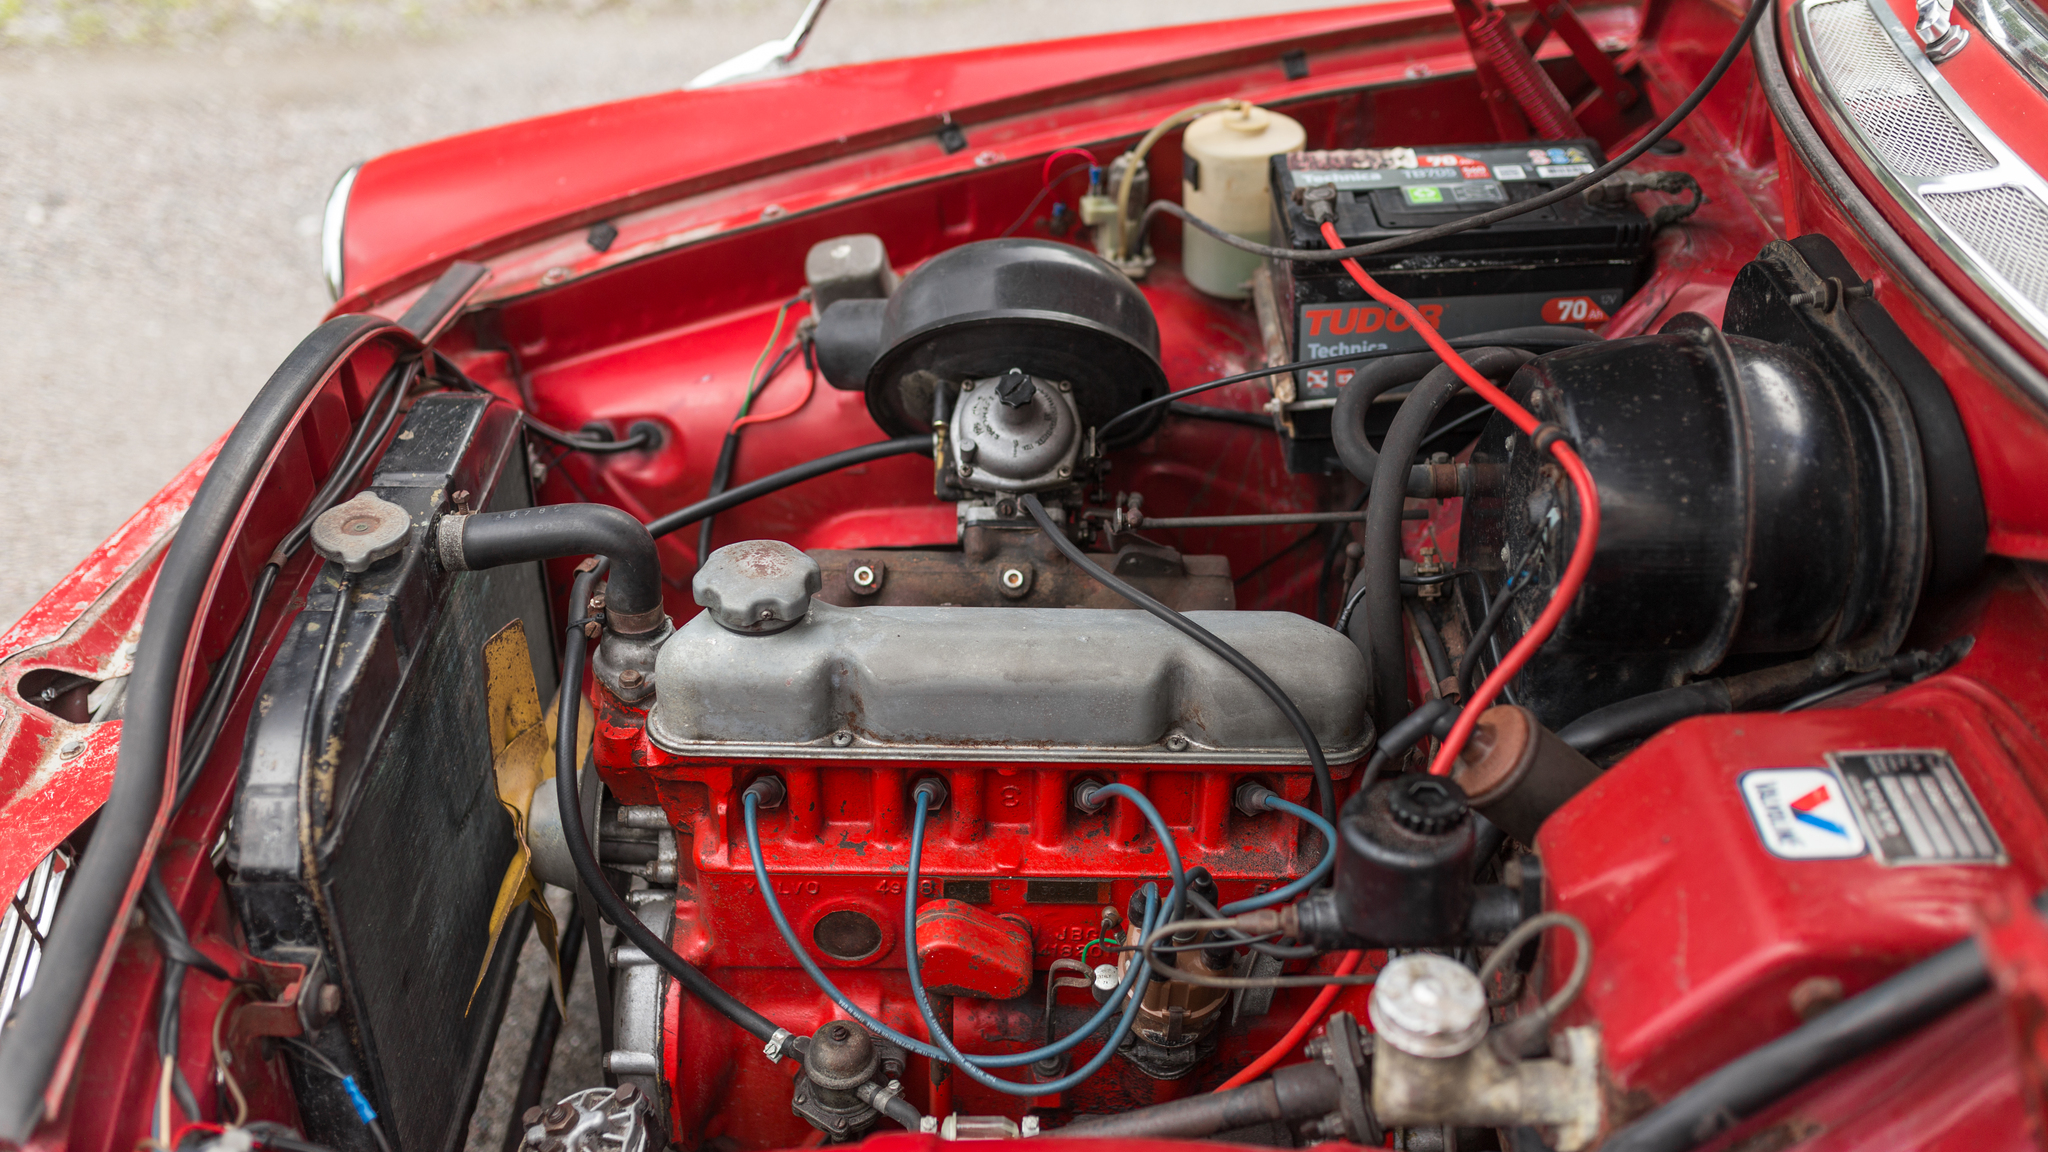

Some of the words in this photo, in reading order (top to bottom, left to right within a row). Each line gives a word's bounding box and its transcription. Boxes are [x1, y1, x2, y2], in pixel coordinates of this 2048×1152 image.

[1301, 172, 1383, 184] Technica
[1557, 299, 1588, 321] 70
[1305, 304, 1443, 336] TUDOR
[742, 880, 820, 895] VLVO
